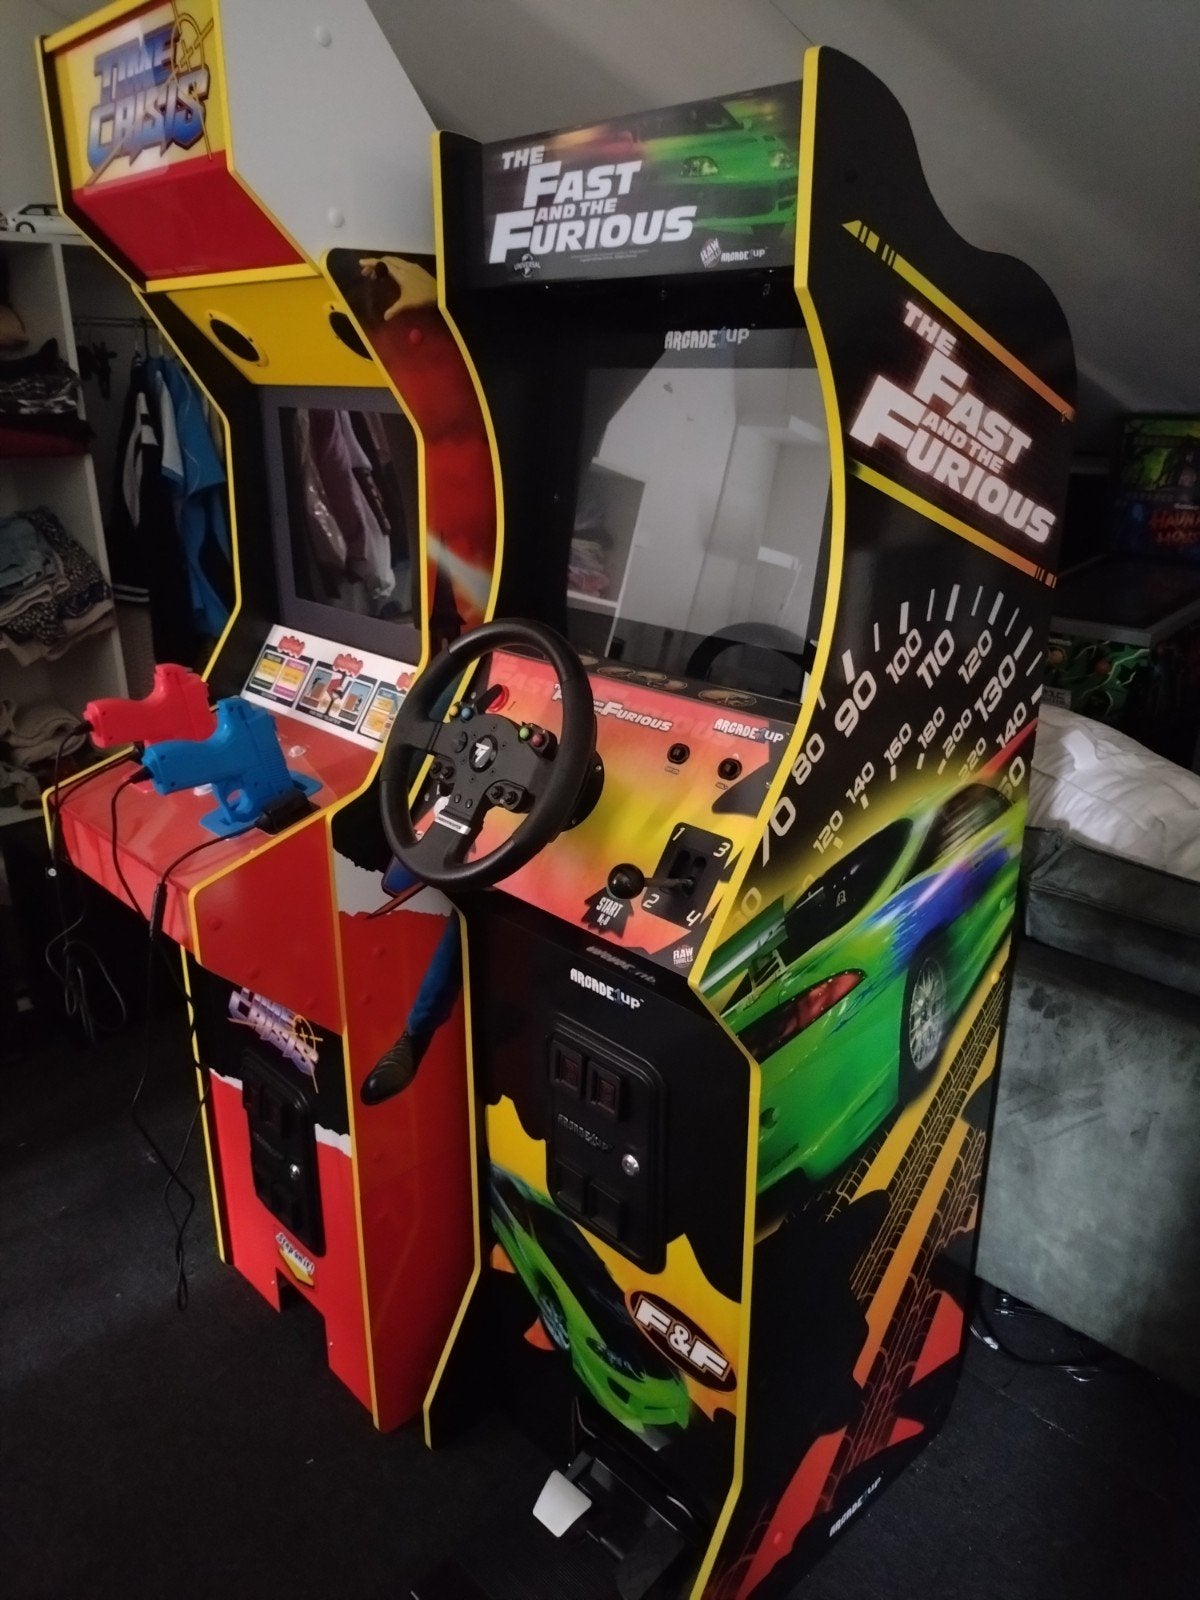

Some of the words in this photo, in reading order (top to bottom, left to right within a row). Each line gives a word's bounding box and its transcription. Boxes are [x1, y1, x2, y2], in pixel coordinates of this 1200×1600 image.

[94, 21, 181, 98] TIME
[87, 63, 210, 172] CRISIS
[502, 145, 545, 170] THE
[522, 160, 642, 209] FAST
[488, 205, 698, 264] FURIOUS
[534, 201, 575, 223] AND
[579, 199, 618, 217] THE
[903, 300, 957, 358] THE
[912, 347, 1033, 465] FAST
[850, 374, 1056, 544] FURIOUS
[922, 411, 967, 450] AND
[967, 440, 1005, 474] THE
[886, 628, 923, 684] 100
[916, 629, 955, 689] 110
[958, 629, 993, 684] 120
[834, 670, 877, 738] 90
[974, 655, 1016, 722] 130
[603, 701, 673, 732] FURIOUS
[917, 706, 945, 750] 180
[942, 708, 972, 759] 200
[995, 702, 1027, 751] 140
[791, 733, 825, 785] 80
[884, 722, 912, 766] 160
[958, 737, 987, 781] 220
[846, 761, 875, 803] 140
[672, 827, 686, 841] 1
[713, 842, 731, 858] 3
[812, 810, 844, 854] 120
[596, 897, 624, 918] START
[642, 894, 660, 908] 2
[686, 910, 702, 927] 4
[634, 1296, 730, 1379] F&F
